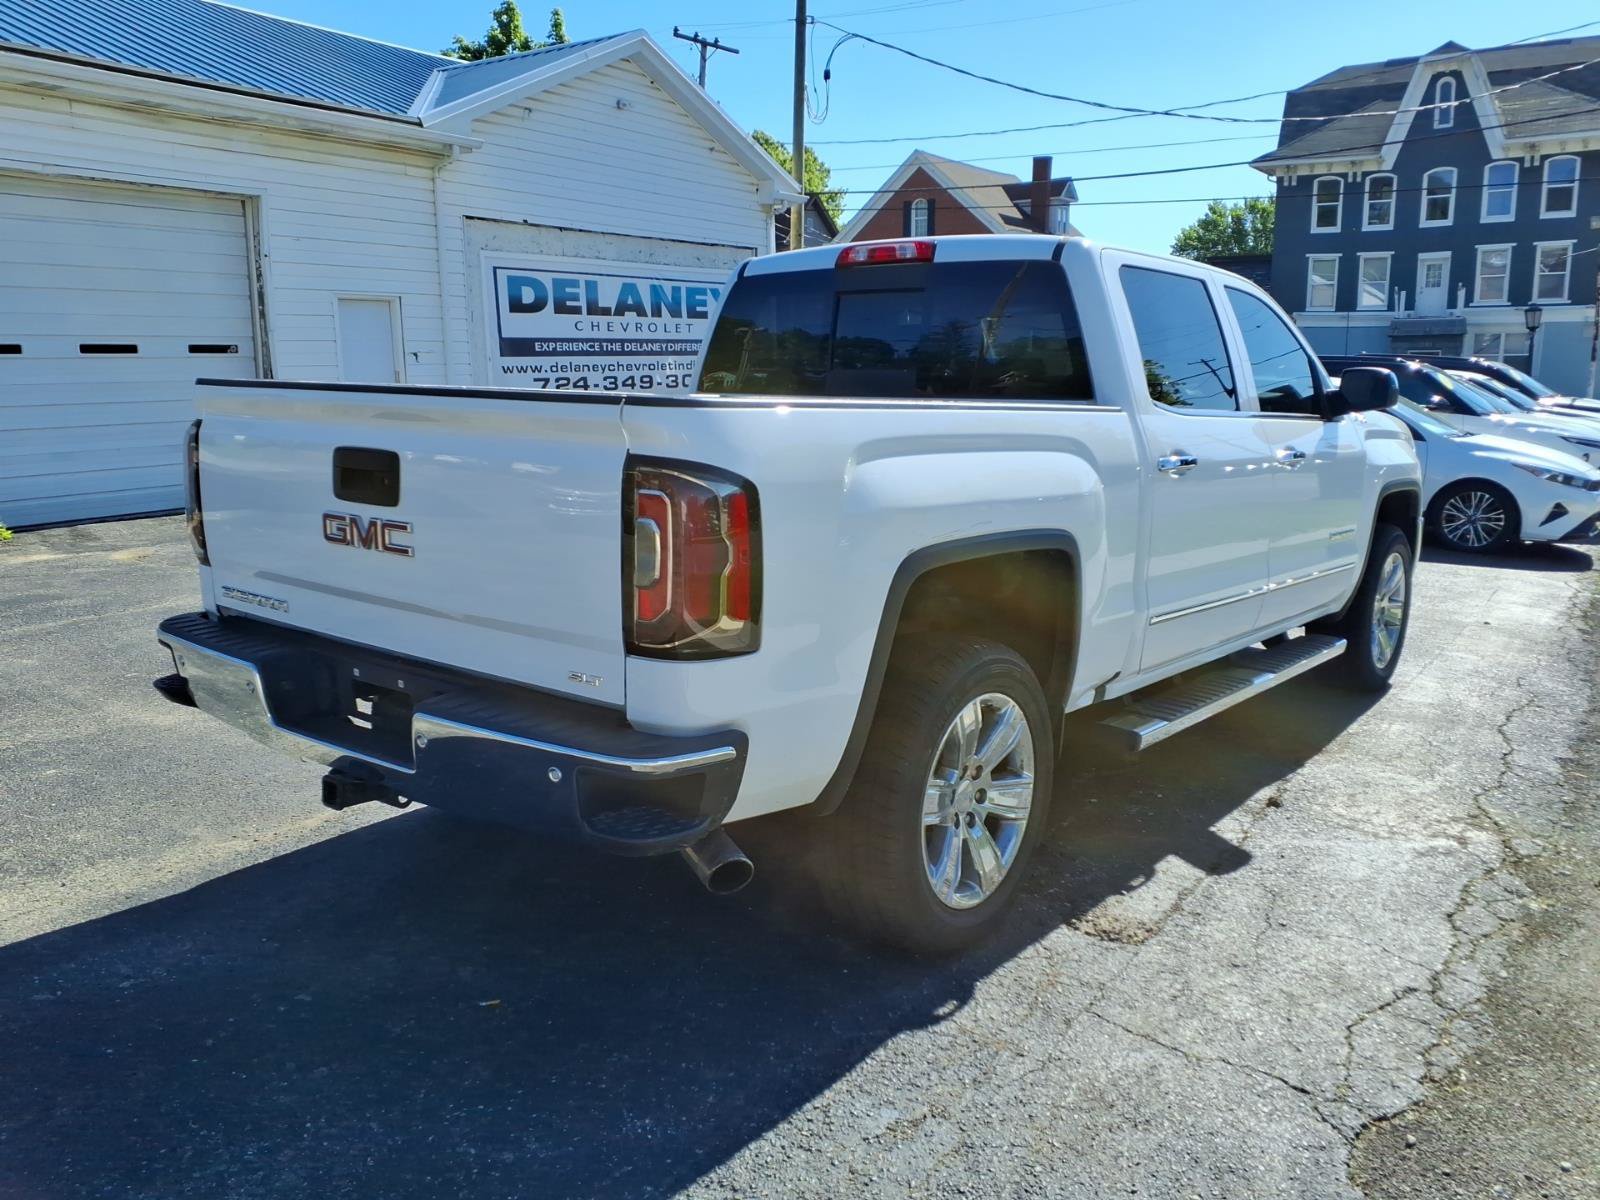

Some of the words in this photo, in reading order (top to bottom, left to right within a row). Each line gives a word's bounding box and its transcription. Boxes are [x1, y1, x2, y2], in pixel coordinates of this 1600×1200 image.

[575, 321, 693, 333] CHEVROLET
[534, 341, 600, 352] EXPERIENCE
[602, 342, 622, 352] THE
[624, 342, 666, 352] DELANEY
[322, 511, 415, 557] GMC
